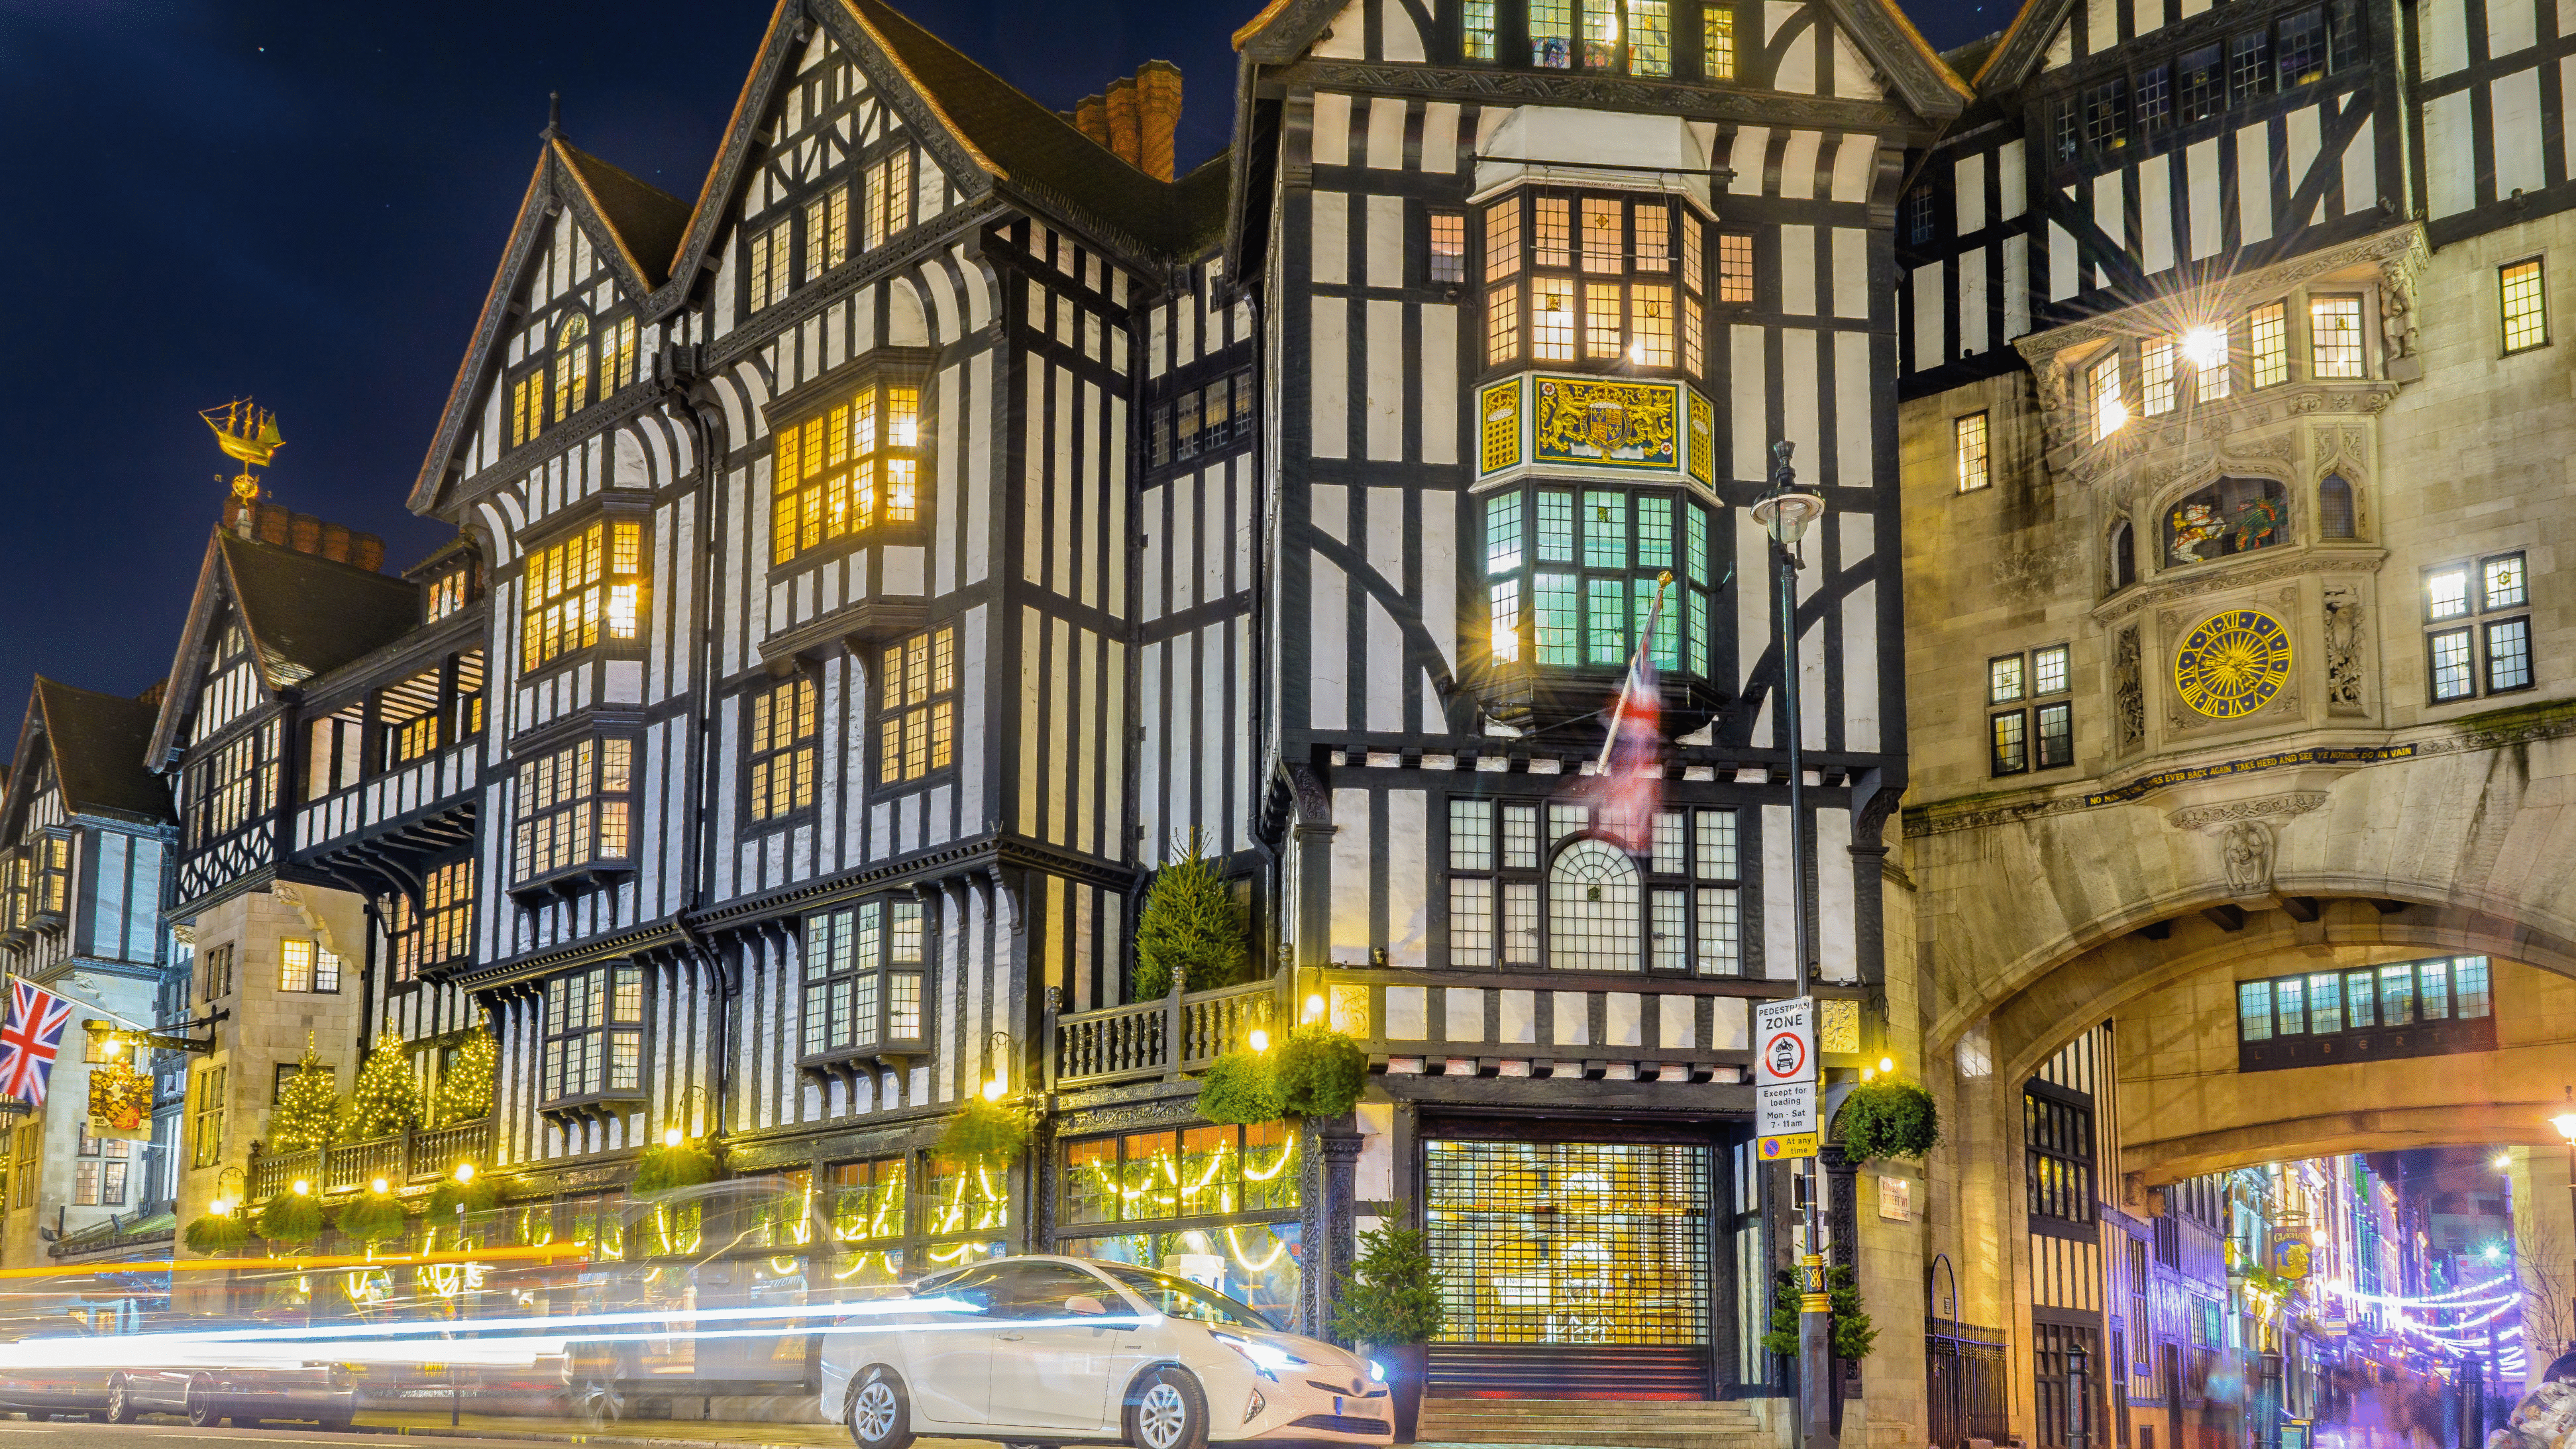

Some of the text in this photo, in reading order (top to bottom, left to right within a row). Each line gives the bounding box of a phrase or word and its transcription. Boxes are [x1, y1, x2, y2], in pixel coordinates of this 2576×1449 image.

[2221, 612, 2240, 631] XII
[2251, 614, 2261, 630] I
[2198, 621, 2218, 640] XI
[2264, 627, 2282, 642] II
[2183, 643, 2200, 657] X
[2273, 649, 2289, 662] III
[2178, 665, 2195, 680] IX
[2266, 670, 2285, 687] IIII
[2200, 696, 2218, 715] VII
[2253, 690, 2268, 706] V
[2228, 700, 2245, 715] VI
[2090, 796, 2102, 805] NO
[2165, 773, 2185, 782] EVER
[2187, 769, 2208, 779] BACK
[2210, 766, 2231, 775] AGAIN
[2235, 761, 2255, 771] TAKE
[2257, 758, 2277, 768] HEED
[2279, 754, 2297, 764] AND
[2298, 752, 2313, 761] SEE
[2390, 747, 2412, 757] VAIN
[1766, 1014, 1803, 1030] ZONE
[2255, 1032, 2440, 1060] LIBERT
[1764, 1089, 1792, 1097] Except
[1884, 1193, 1900, 1206] STEET
